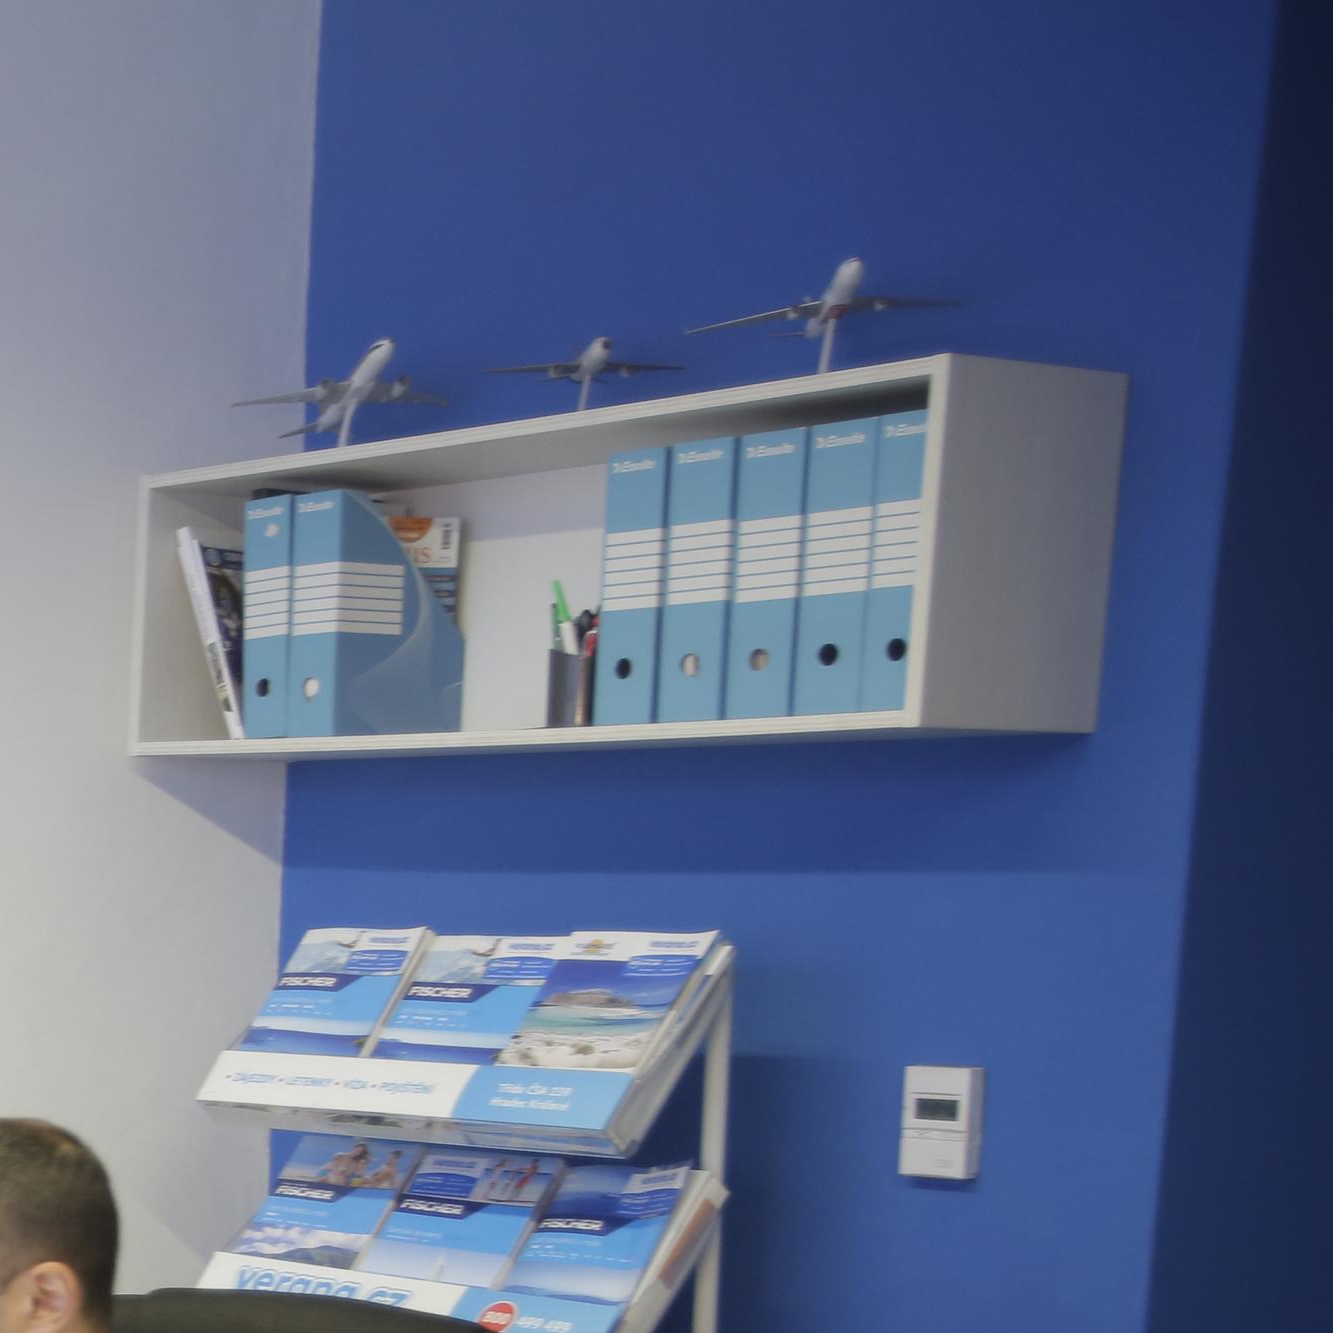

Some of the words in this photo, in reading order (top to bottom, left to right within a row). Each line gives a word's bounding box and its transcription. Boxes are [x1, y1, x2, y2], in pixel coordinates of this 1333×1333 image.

[278, 976, 338, 987] FISCHER
[406, 985, 474, 999] FISCHER
[274, 1184, 336, 1201] FISCHER
[399, 1198, 465, 1215] FISCHER
[537, 1217, 605, 1231] FISCHER
